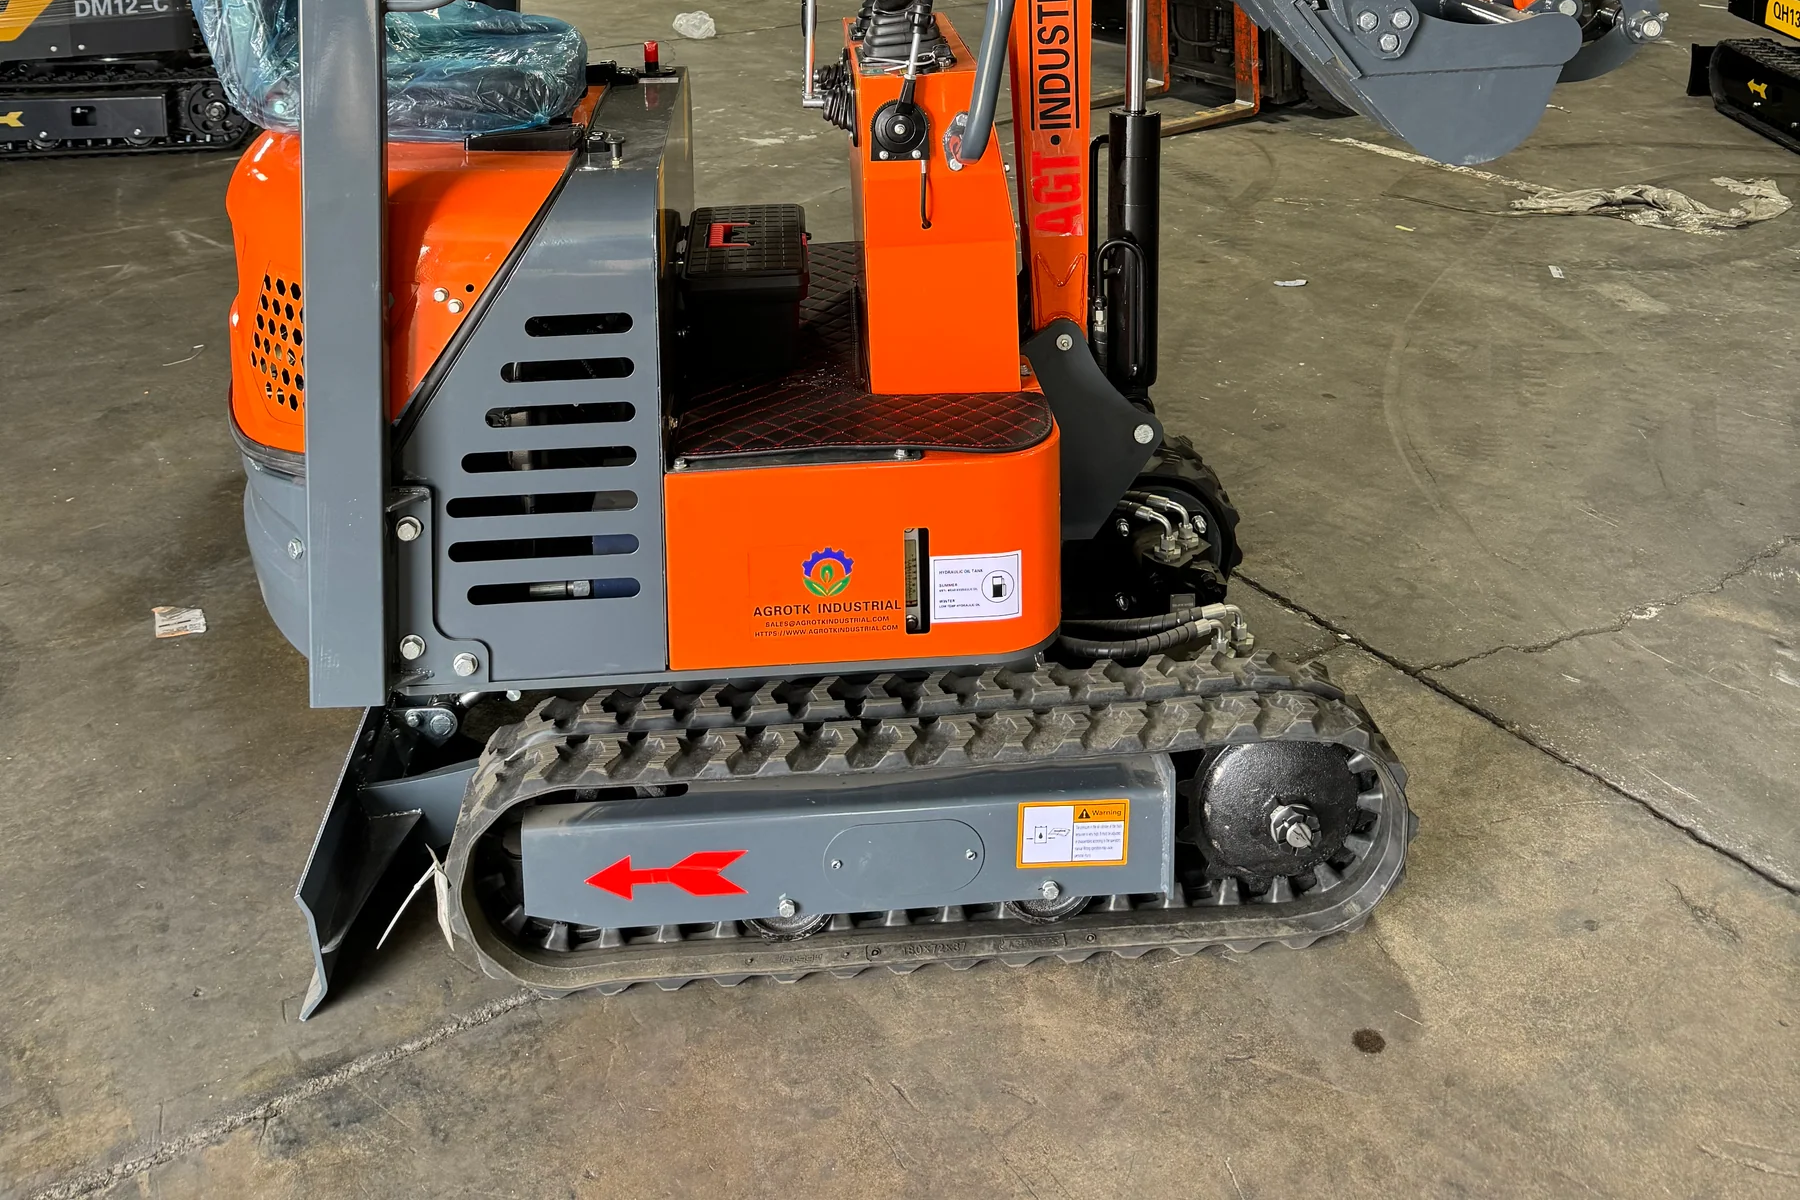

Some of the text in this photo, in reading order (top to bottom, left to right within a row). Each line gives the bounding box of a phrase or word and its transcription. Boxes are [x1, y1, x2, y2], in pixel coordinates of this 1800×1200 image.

[1031, 151, 1082, 234] AGT
[753, 600, 901, 617] AGROTK INDUSTRIAL
[1092, 809, 1122, 817] Warning
